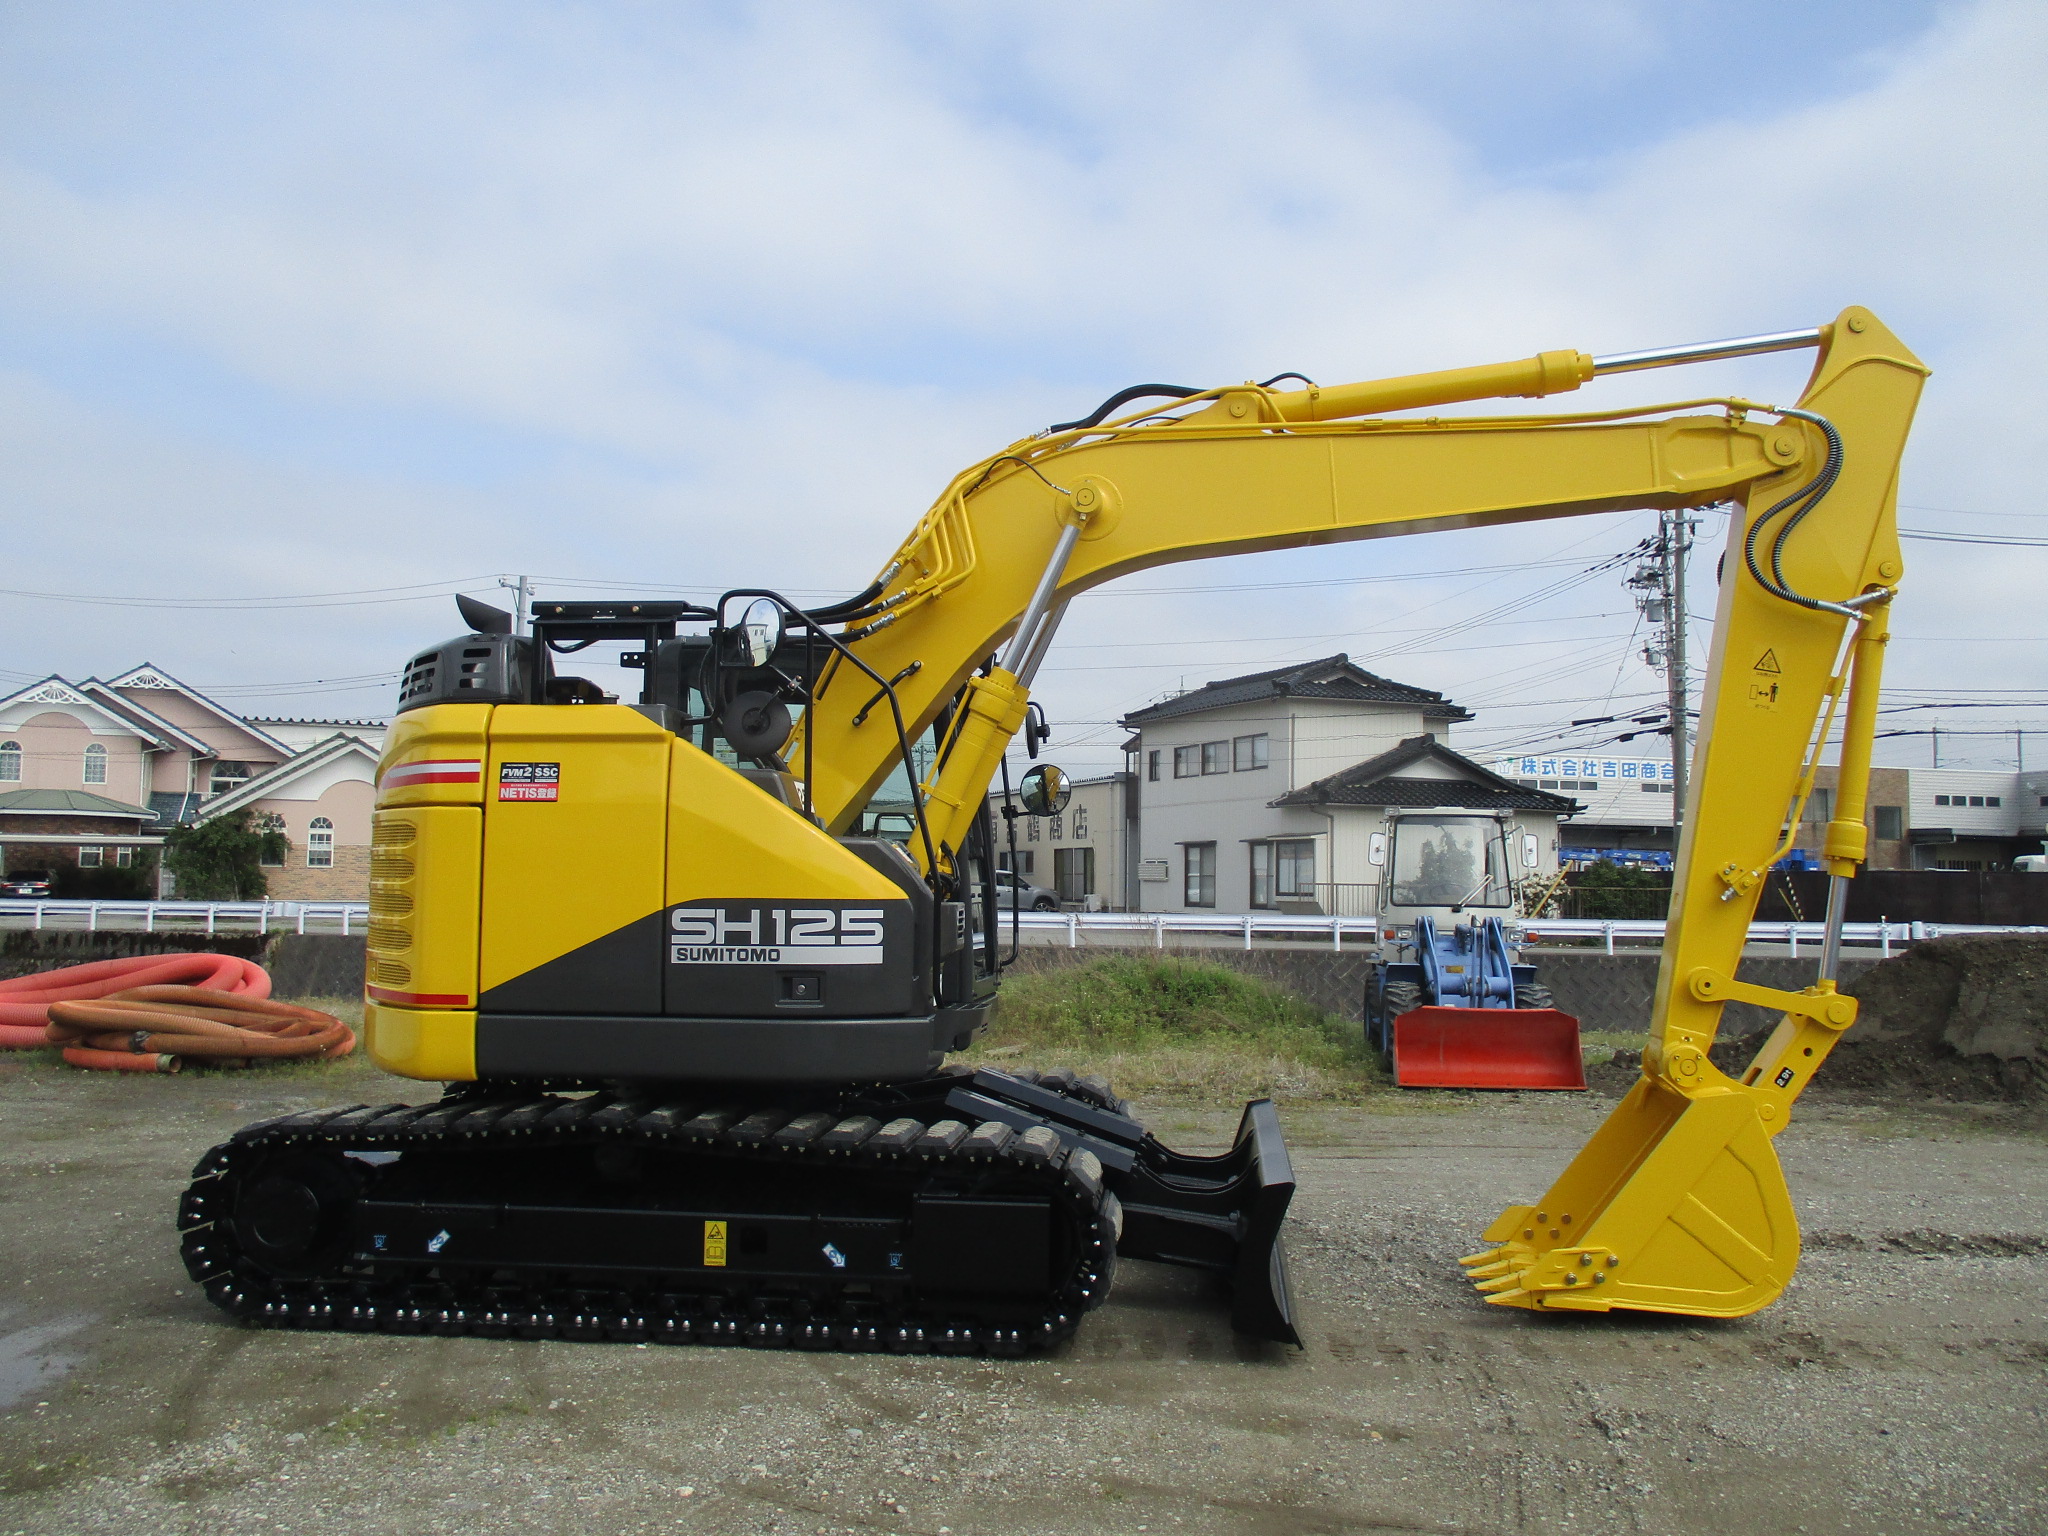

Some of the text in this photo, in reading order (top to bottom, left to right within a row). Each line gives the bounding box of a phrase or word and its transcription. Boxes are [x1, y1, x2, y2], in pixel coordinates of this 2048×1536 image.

[502, 767, 532, 777] FVM2
[535, 767, 558, 777] SSC
[676, 947, 780, 963] SUMITOMO
